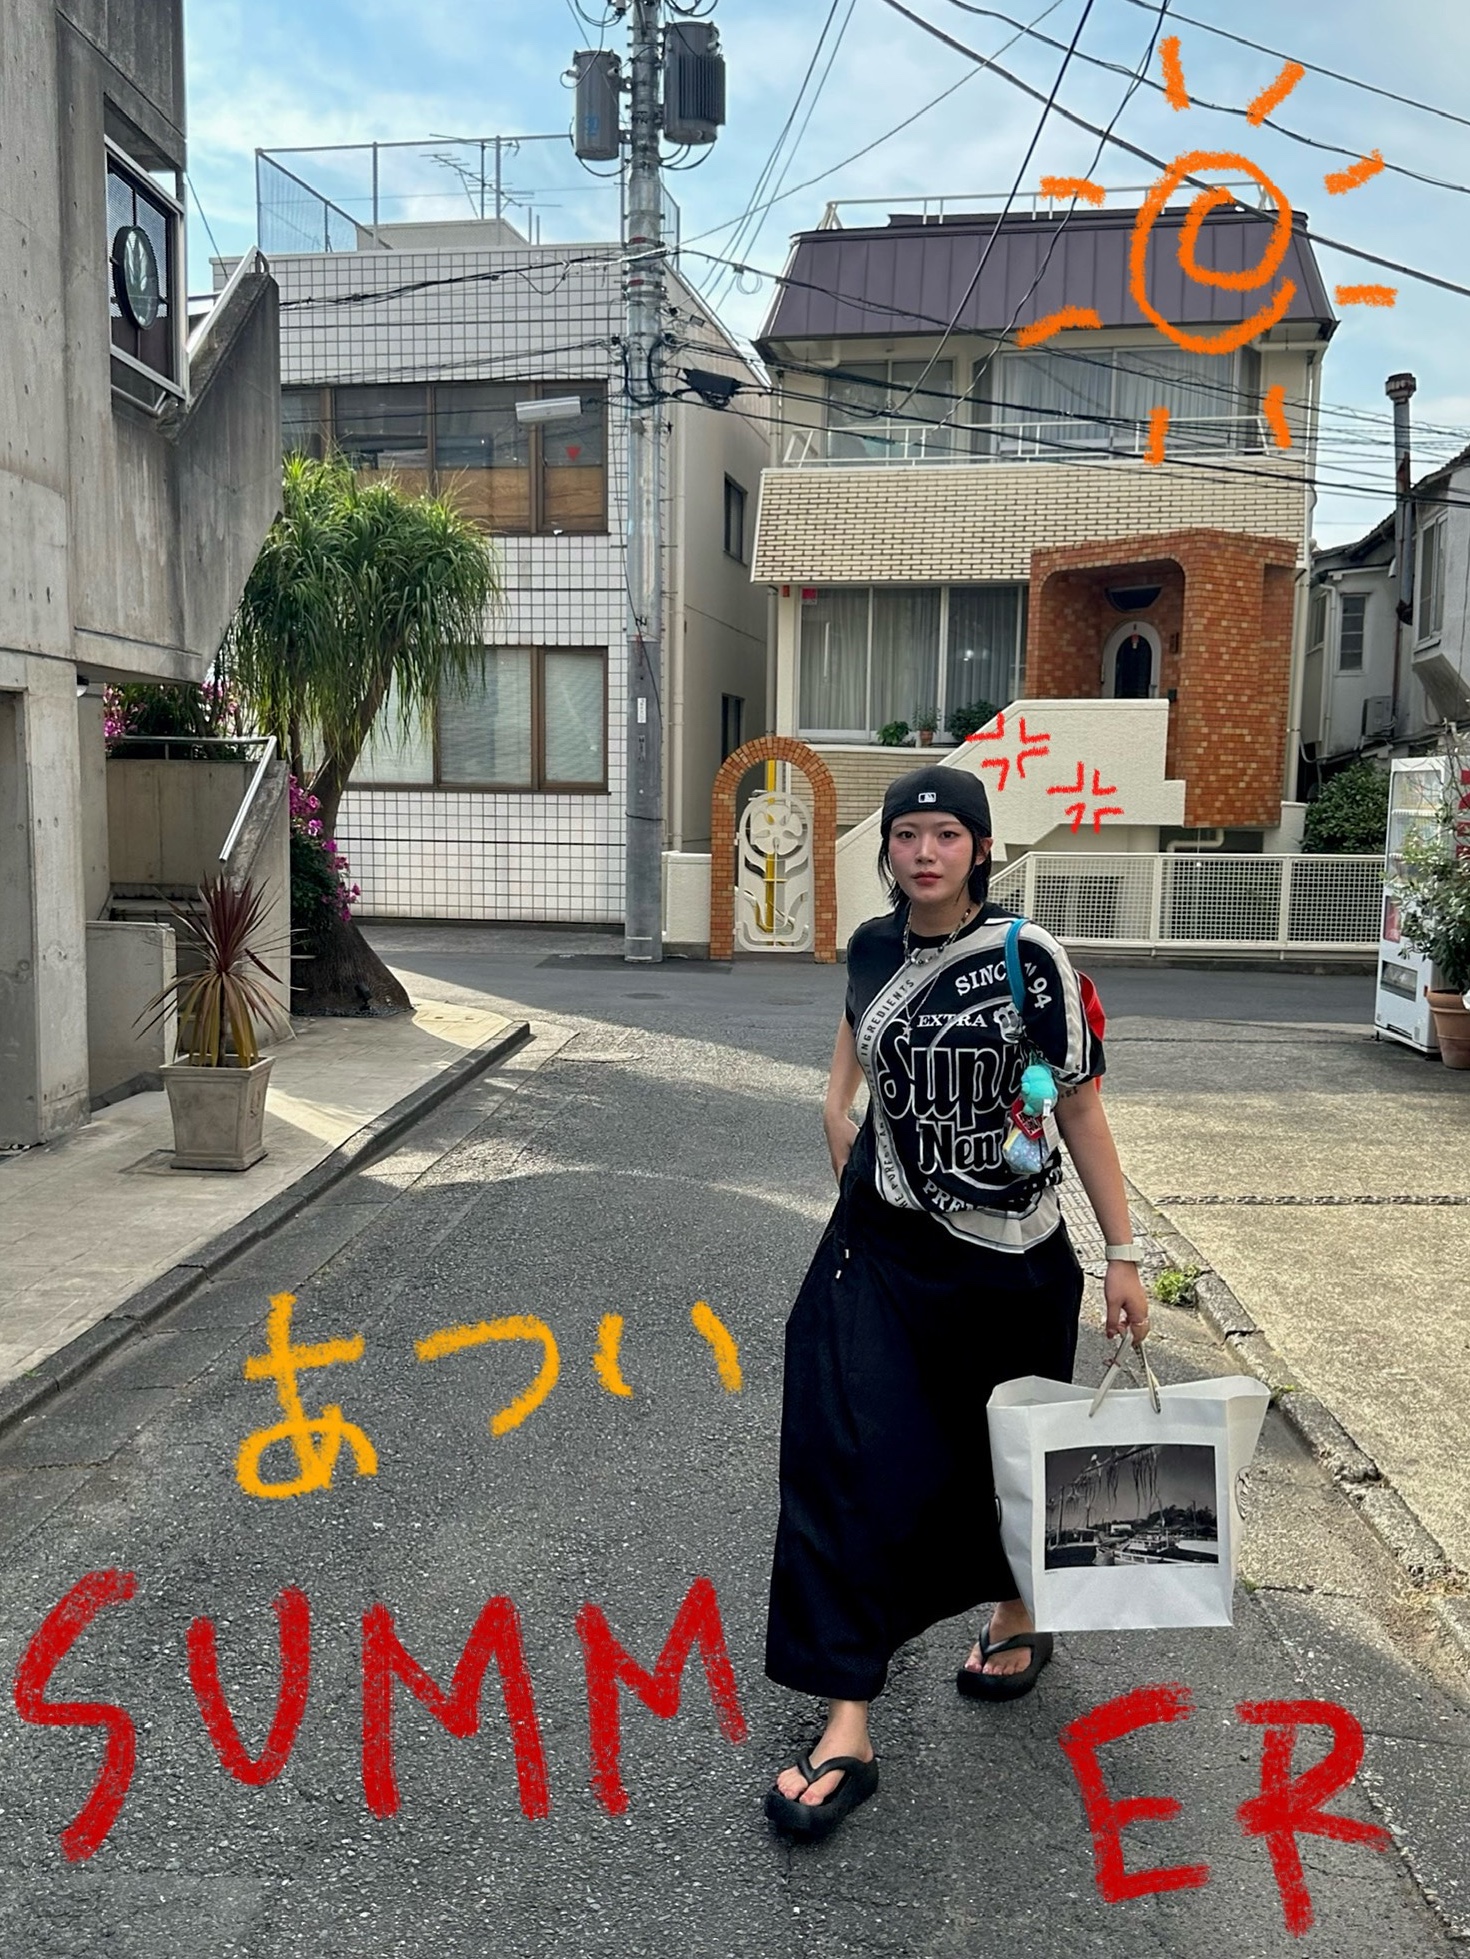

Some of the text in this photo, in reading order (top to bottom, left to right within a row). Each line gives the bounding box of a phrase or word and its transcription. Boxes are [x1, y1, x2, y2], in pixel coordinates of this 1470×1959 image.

[955, 961, 1008, 996] SINC
[860, 979, 915, 1057] INGREDIENTS
[917, 1013, 988, 1029] EXTRA
